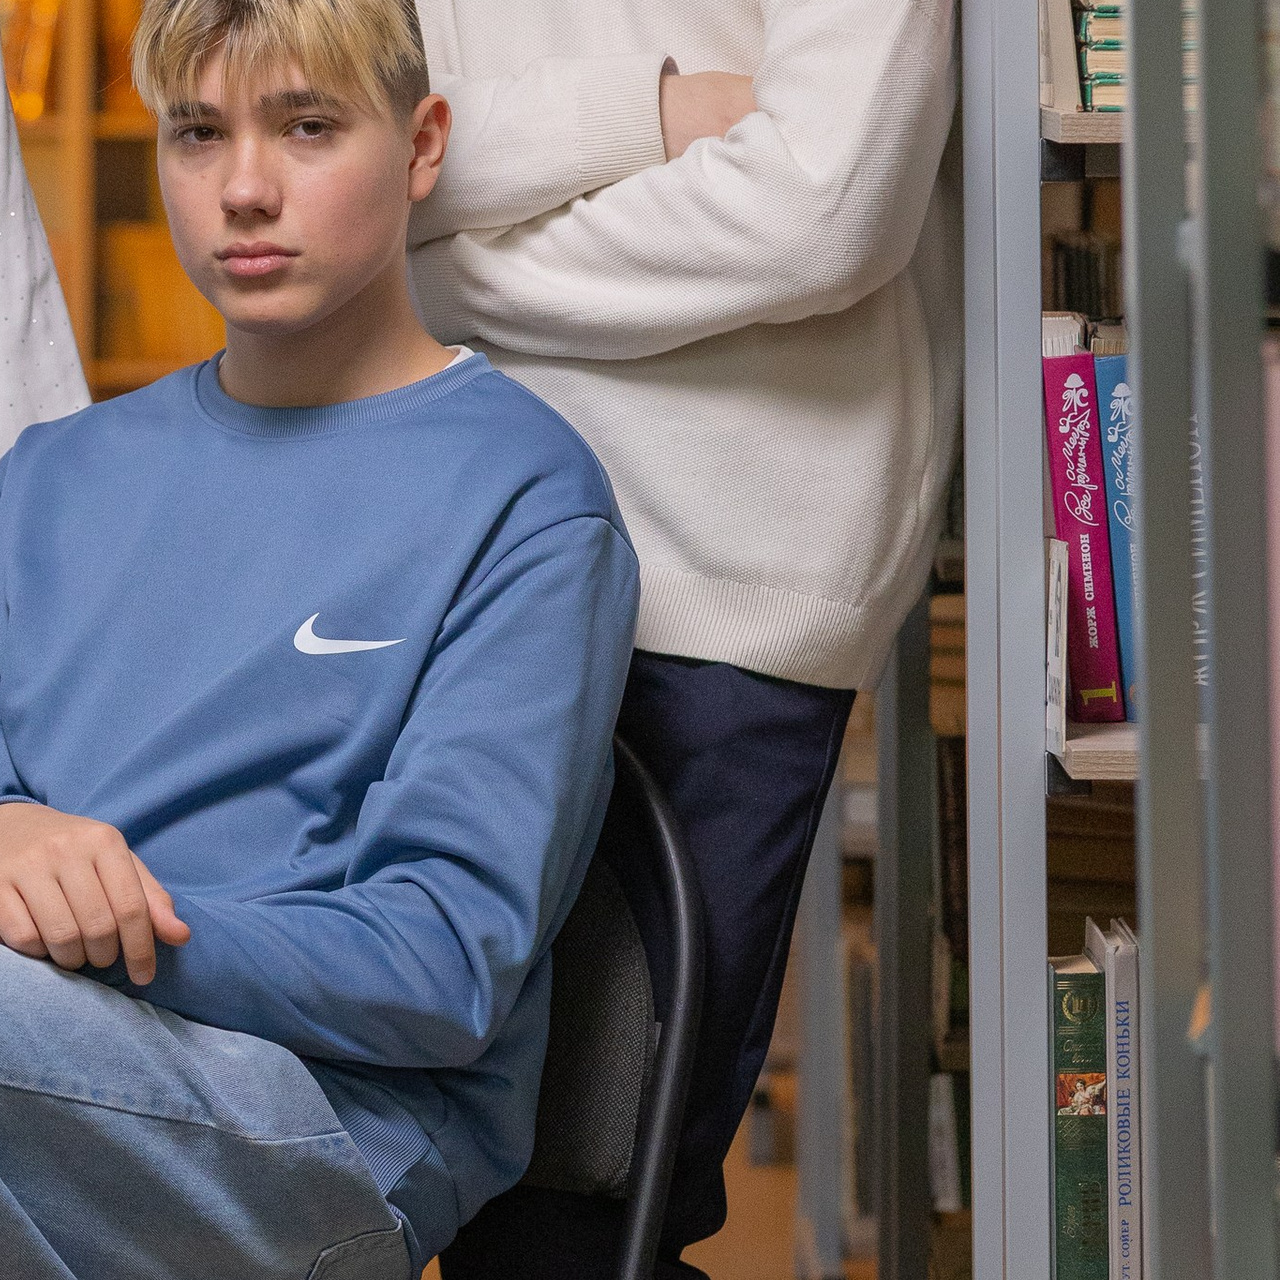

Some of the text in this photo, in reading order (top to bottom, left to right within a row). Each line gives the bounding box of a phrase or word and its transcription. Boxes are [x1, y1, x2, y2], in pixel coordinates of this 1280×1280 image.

[1064, 437, 1100, 527] Все романы
[1079, 533, 1099, 649] ЖОРЖ СИМЕНОН
[1080, 680, 1117, 708] 1
[1115, 1000, 1132, 1207] РОЛИКОВЫЕ КОНЬКИ
[1120, 1219, 1131, 1258] СОЙЕР
